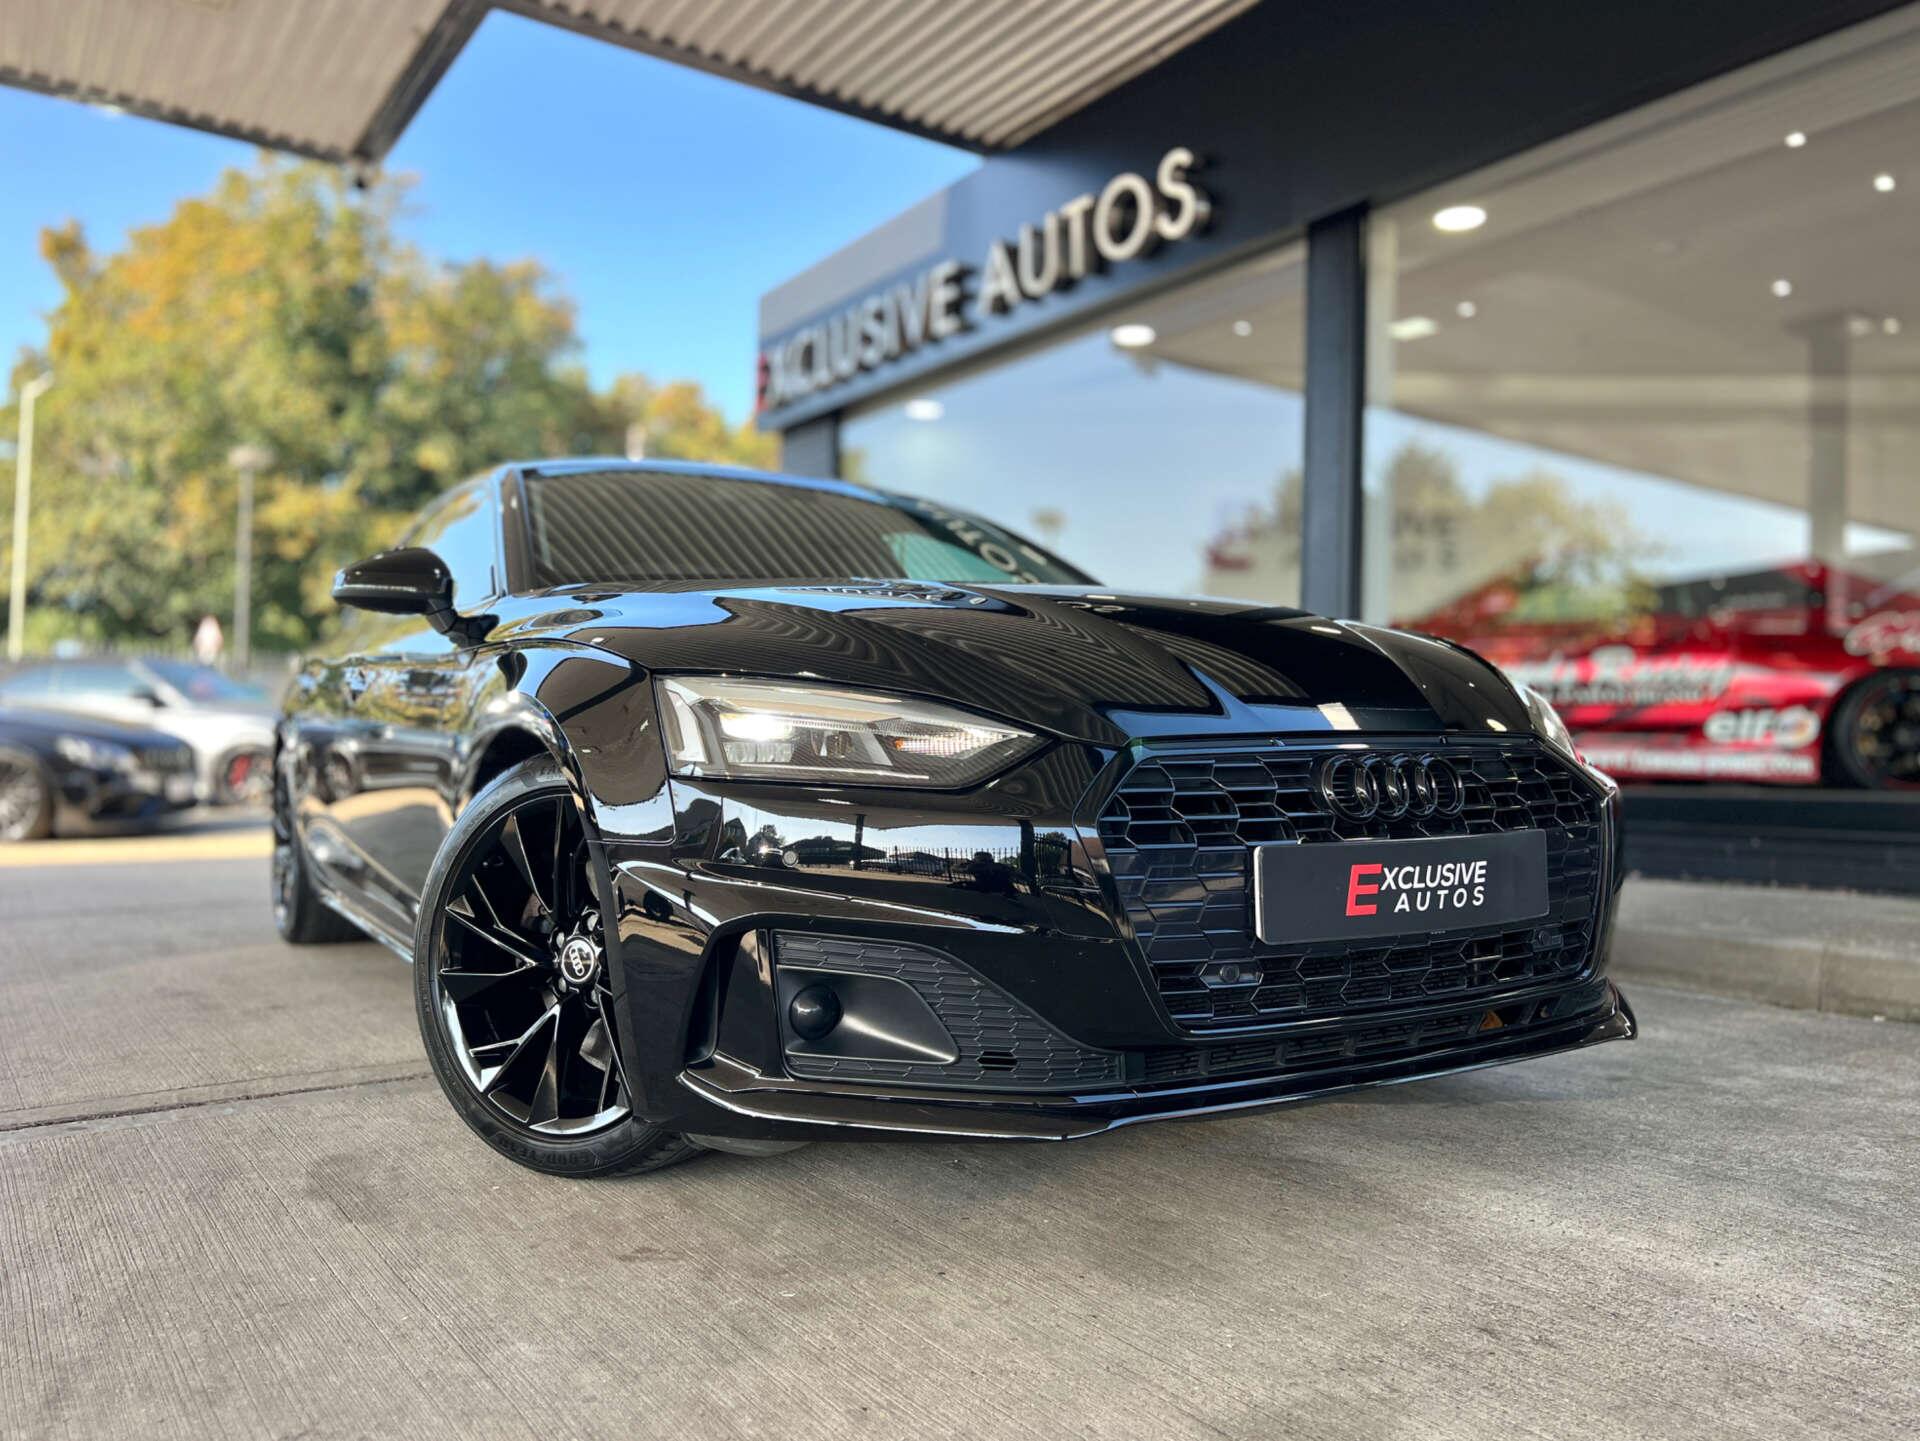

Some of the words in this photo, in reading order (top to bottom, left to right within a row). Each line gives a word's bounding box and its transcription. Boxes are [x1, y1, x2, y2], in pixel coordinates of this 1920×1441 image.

[756, 260, 962, 413] EXCLUSIVE
[977, 147, 1197, 315] AUTOS
[1345, 860, 1488, 916] EXCLUSIVE
[1393, 885, 1485, 913] AUTOS
